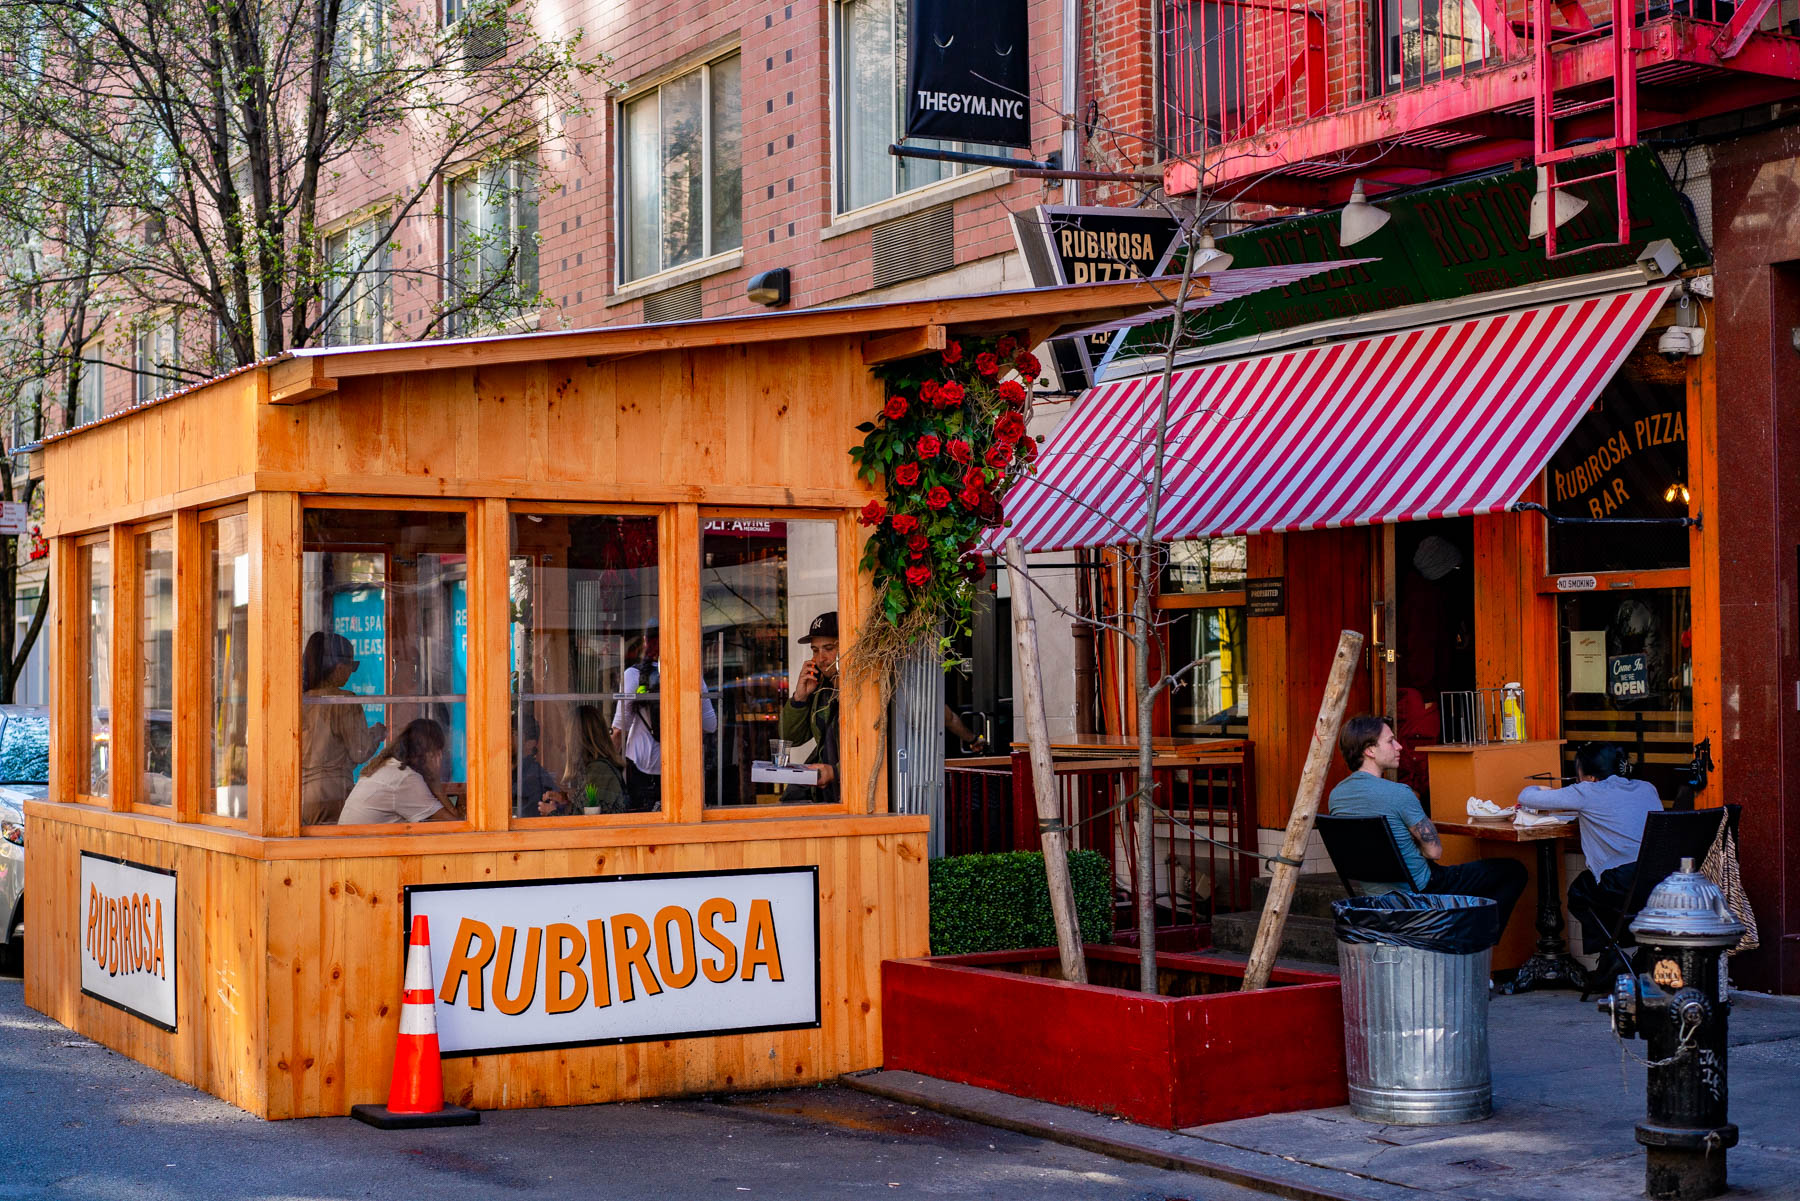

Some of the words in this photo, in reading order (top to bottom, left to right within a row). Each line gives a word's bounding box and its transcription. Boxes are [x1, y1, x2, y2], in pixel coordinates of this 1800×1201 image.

[918, 90, 1023, 120] THEGYM.NYC
[1061, 229, 1155, 261] RUBIROSA
[1073, 262, 1139, 285] PIZZA
[1555, 430, 1632, 502] RUBIROSA
[1634, 411, 1686, 450] PIZZA
[1588, 477, 1631, 520] BAR
[1558, 580, 1567, 589] NO
[1568, 579, 1594, 588] SMOKING
[335, 616, 363, 633] RETAIL
[1613, 659, 1632, 675] Come
[1614, 680, 1646, 696] OPEN
[86, 880, 167, 982] RUBIROSA
[439, 896, 785, 1015] RUBIROSA
